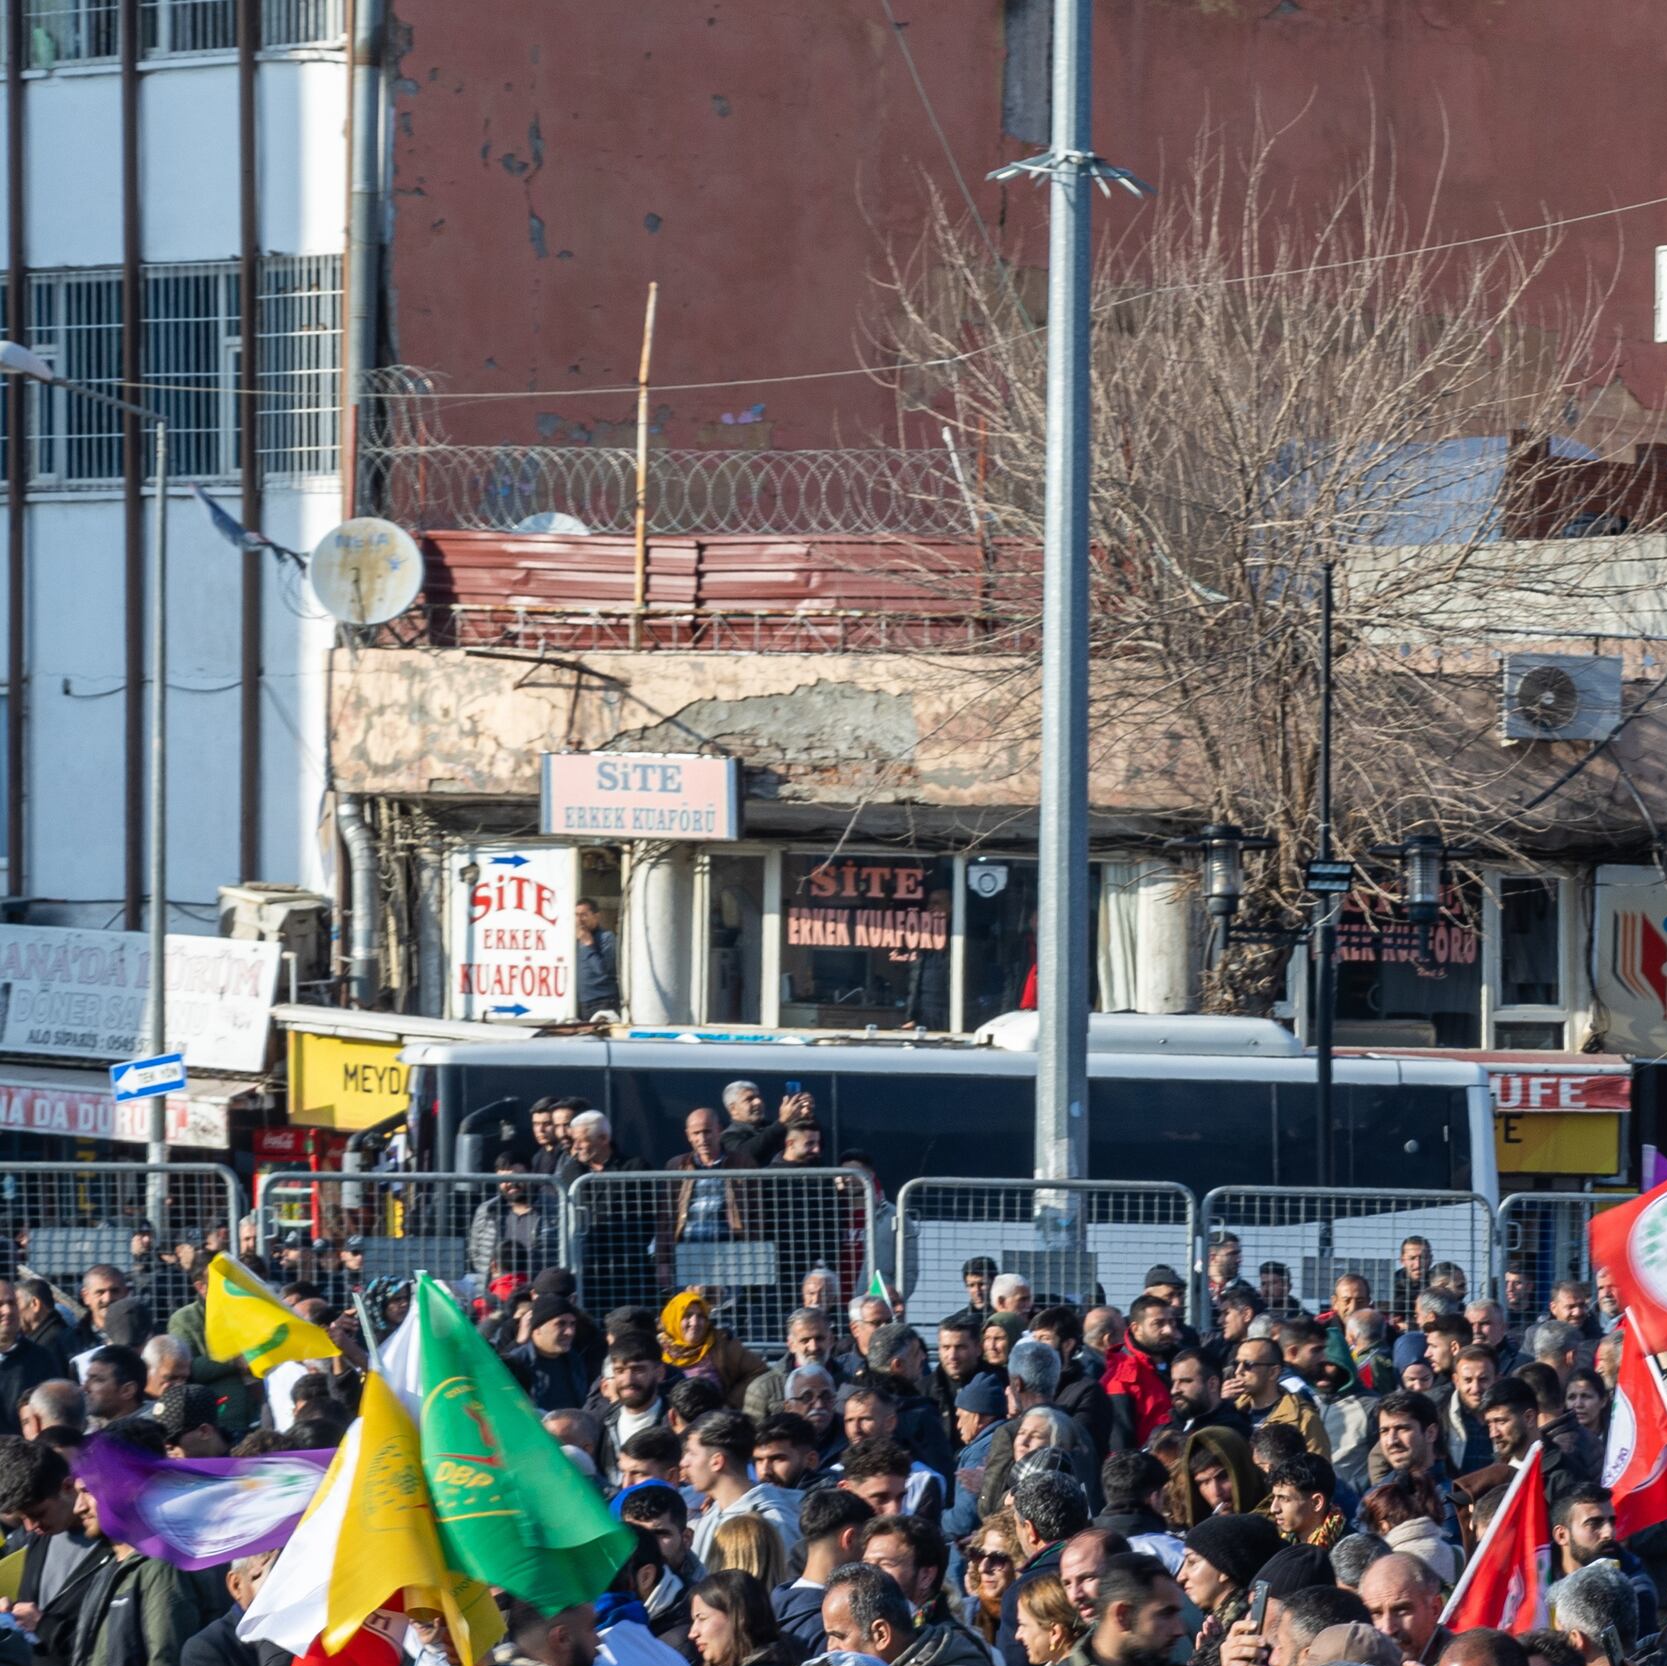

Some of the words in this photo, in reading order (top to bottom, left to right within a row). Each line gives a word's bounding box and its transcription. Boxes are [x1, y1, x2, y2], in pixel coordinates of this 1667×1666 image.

[565, 806, 626, 830] ERKEK
[484, 929, 546, 950] ERKEK
[788, 908, 850, 946] ERKEK
[460, 956, 568, 997] KUAFÖRÜ
[433, 1460, 495, 1489] DBP
